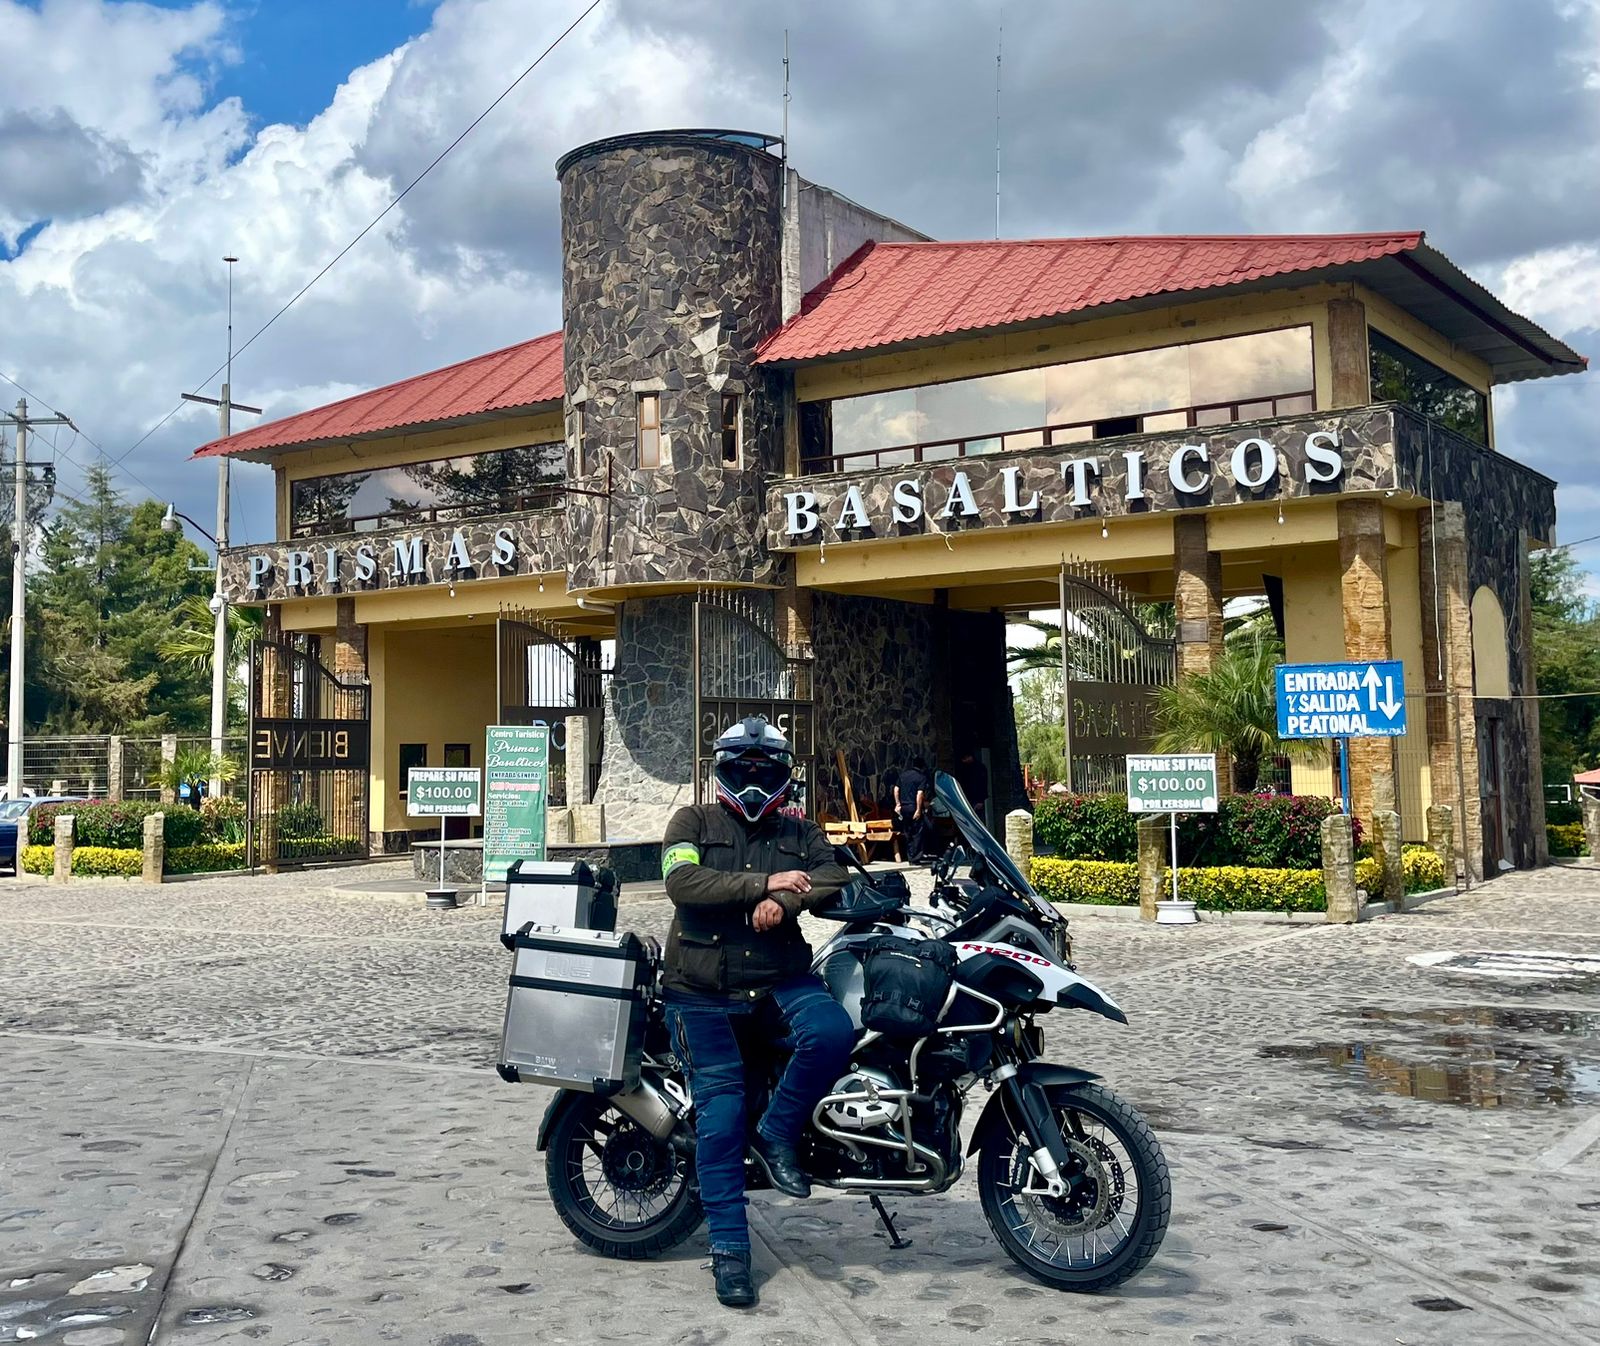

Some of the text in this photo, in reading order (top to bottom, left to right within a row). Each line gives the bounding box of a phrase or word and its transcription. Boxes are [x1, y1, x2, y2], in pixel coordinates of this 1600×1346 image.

[784, 430, 1344, 535] BASALTICOS
[247, 527, 517, 590] PRISMAS
[1284, 671, 1361, 693] ENTRADA
[1298, 693, 1361, 713] SALIDA
[1287, 714, 1370, 735] PEATONAL
[490, 730, 514, 738] Centro
[492, 739, 541, 753] Prismas
[1128, 758, 1214, 771] PREPARE SU PAGO
[410, 771, 480, 781] PREPARE SU PAGO
[416, 785, 472, 800] $100.00
[1138, 776, 1206, 794] $100.00
[420, 804, 466, 812] POR PERSONA
[1143, 799, 1201, 809] POR PERSONA
[962, 943, 1052, 968] R1200
